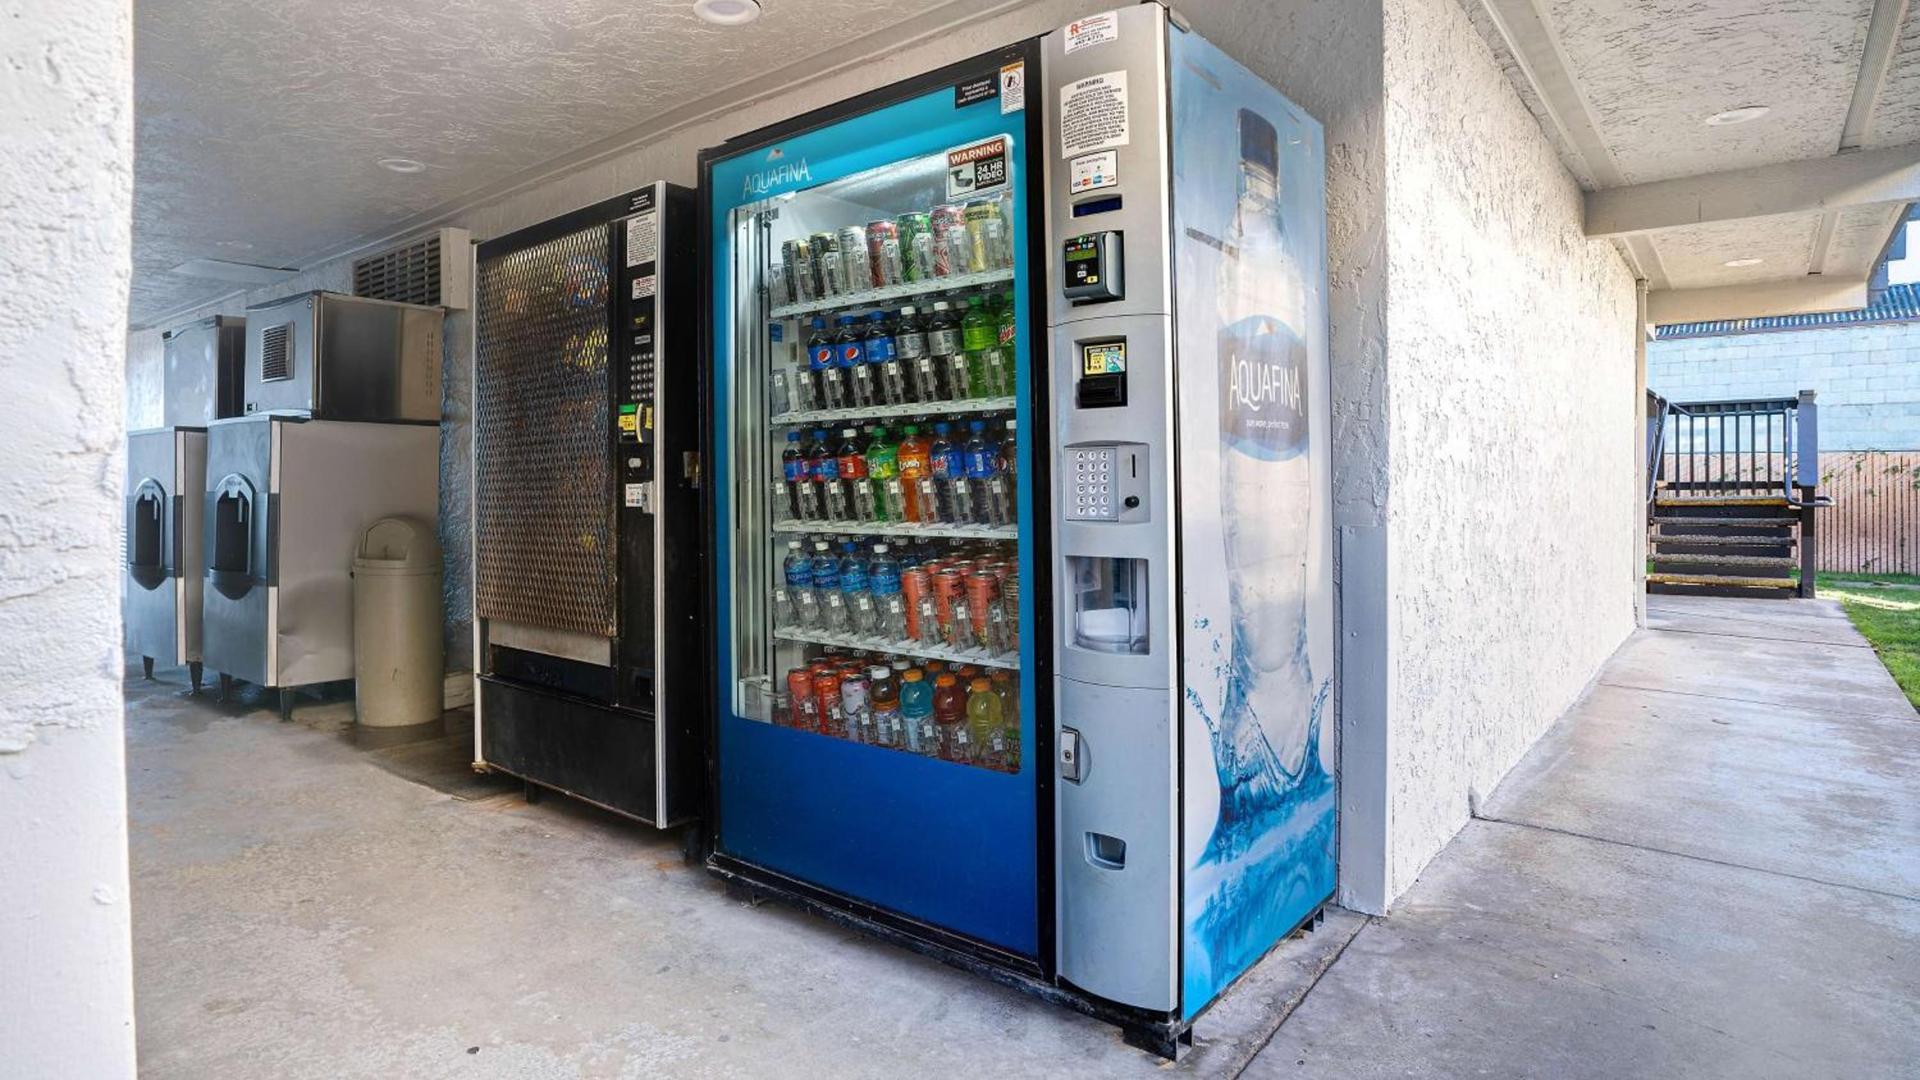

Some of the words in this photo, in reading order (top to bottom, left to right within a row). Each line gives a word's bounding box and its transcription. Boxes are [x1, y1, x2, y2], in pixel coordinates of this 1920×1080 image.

[950, 141, 1004, 166] WARNING
[743, 157, 811, 201] AQUAFINA
[977, 164, 988, 176] 24
[990, 160, 1004, 172] HR
[977, 169, 1004, 182] VIDEO
[1229, 352, 1304, 417] AQUAFINA
